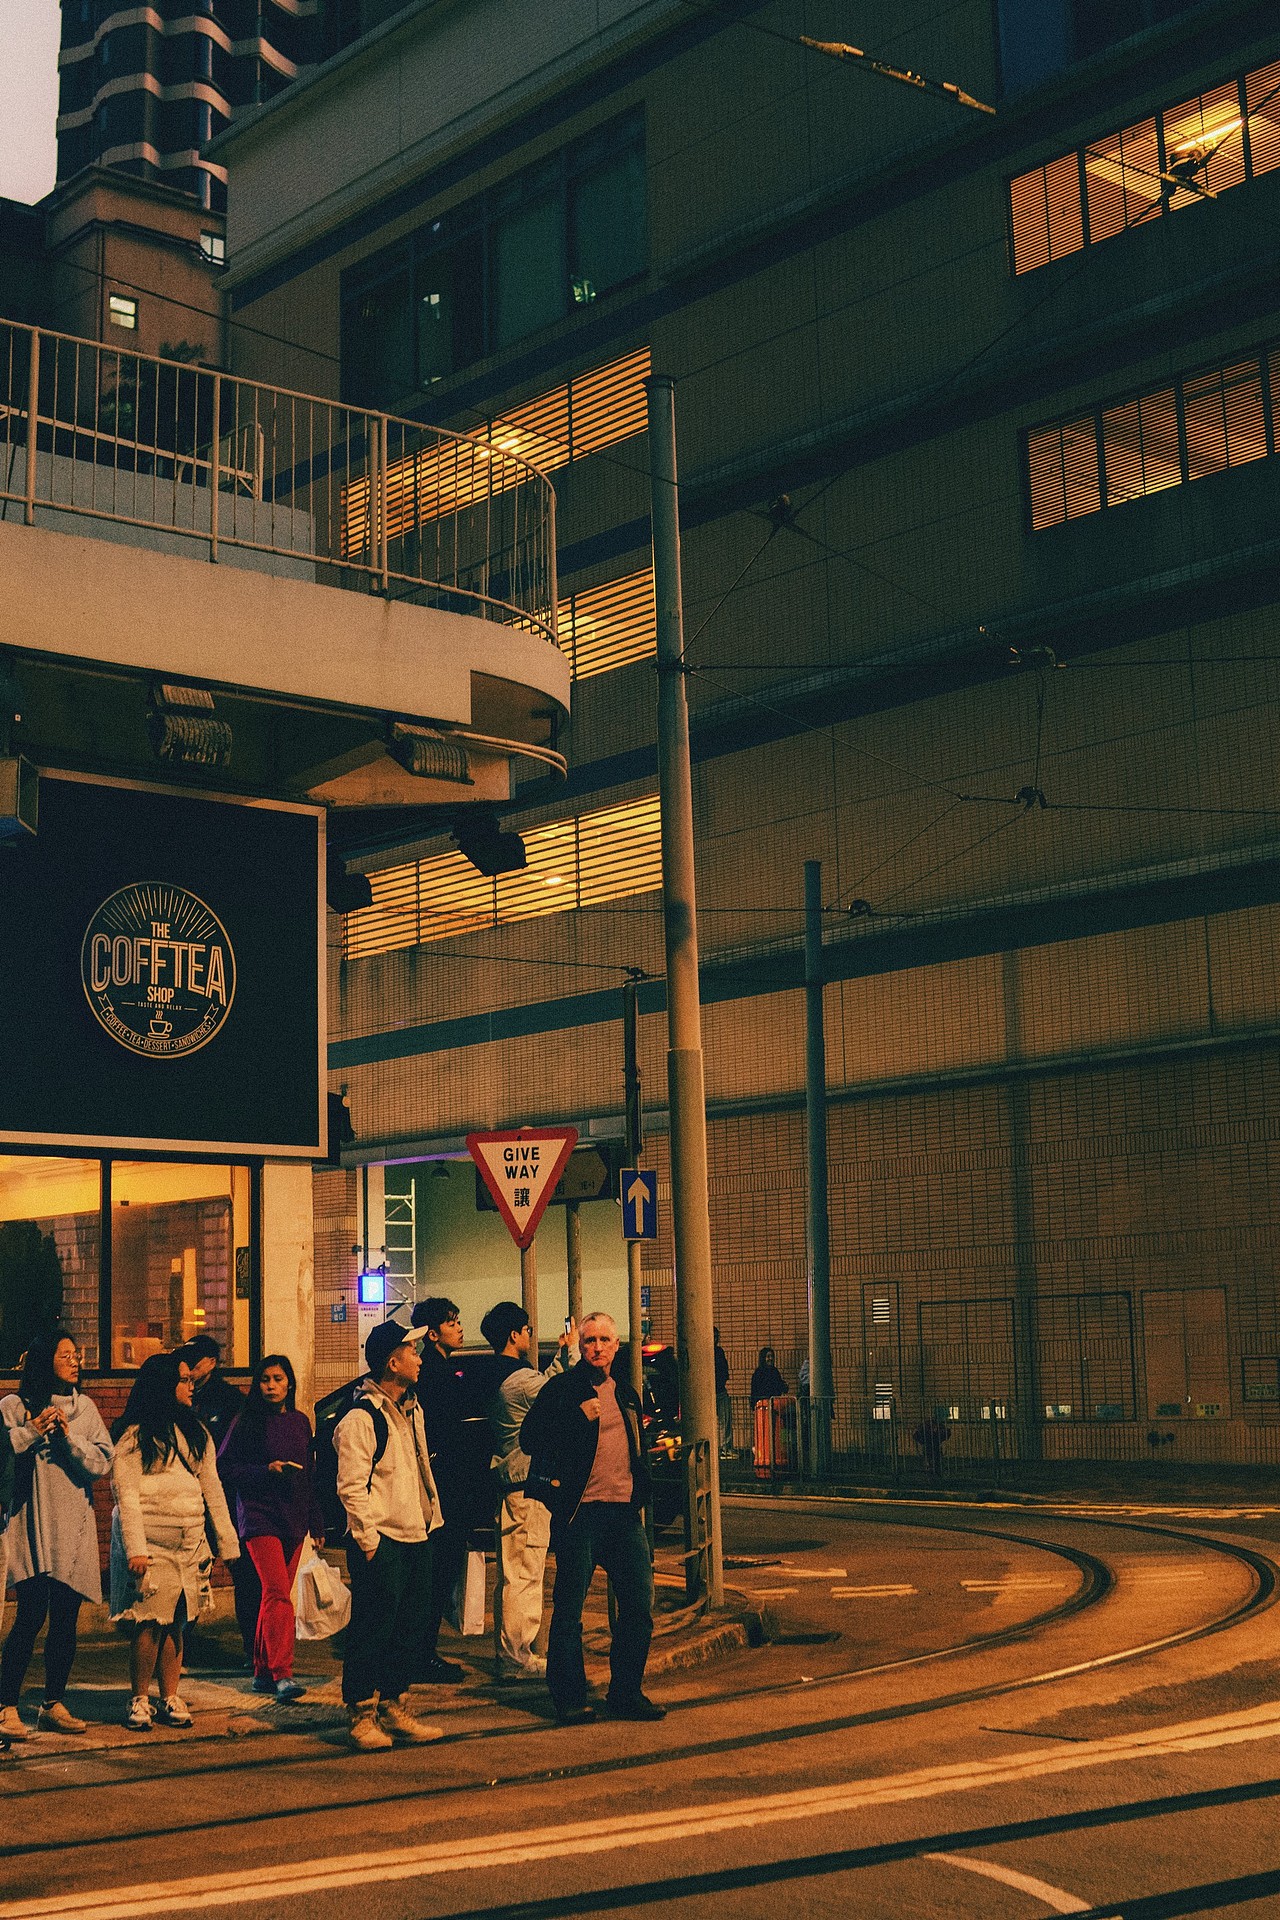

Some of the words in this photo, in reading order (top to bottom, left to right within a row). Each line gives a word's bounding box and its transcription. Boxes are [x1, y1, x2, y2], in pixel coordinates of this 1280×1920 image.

[150, 921, 171, 939] THE
[91, 933, 227, 1007] COFFTEA
[147, 986, 175, 1004] SHOP
[106, 1013, 127, 1038] COFFEE
[129, 1033, 141, 1046] TEA
[143, 1039, 172, 1051] DESSERT
[174, 1023, 211, 1048] SANDWICHES
[503, 1146, 540, 1161] GIVE
[505, 1165, 540, 1179] WAY
[514, 1188, 530, 1207] 讓
